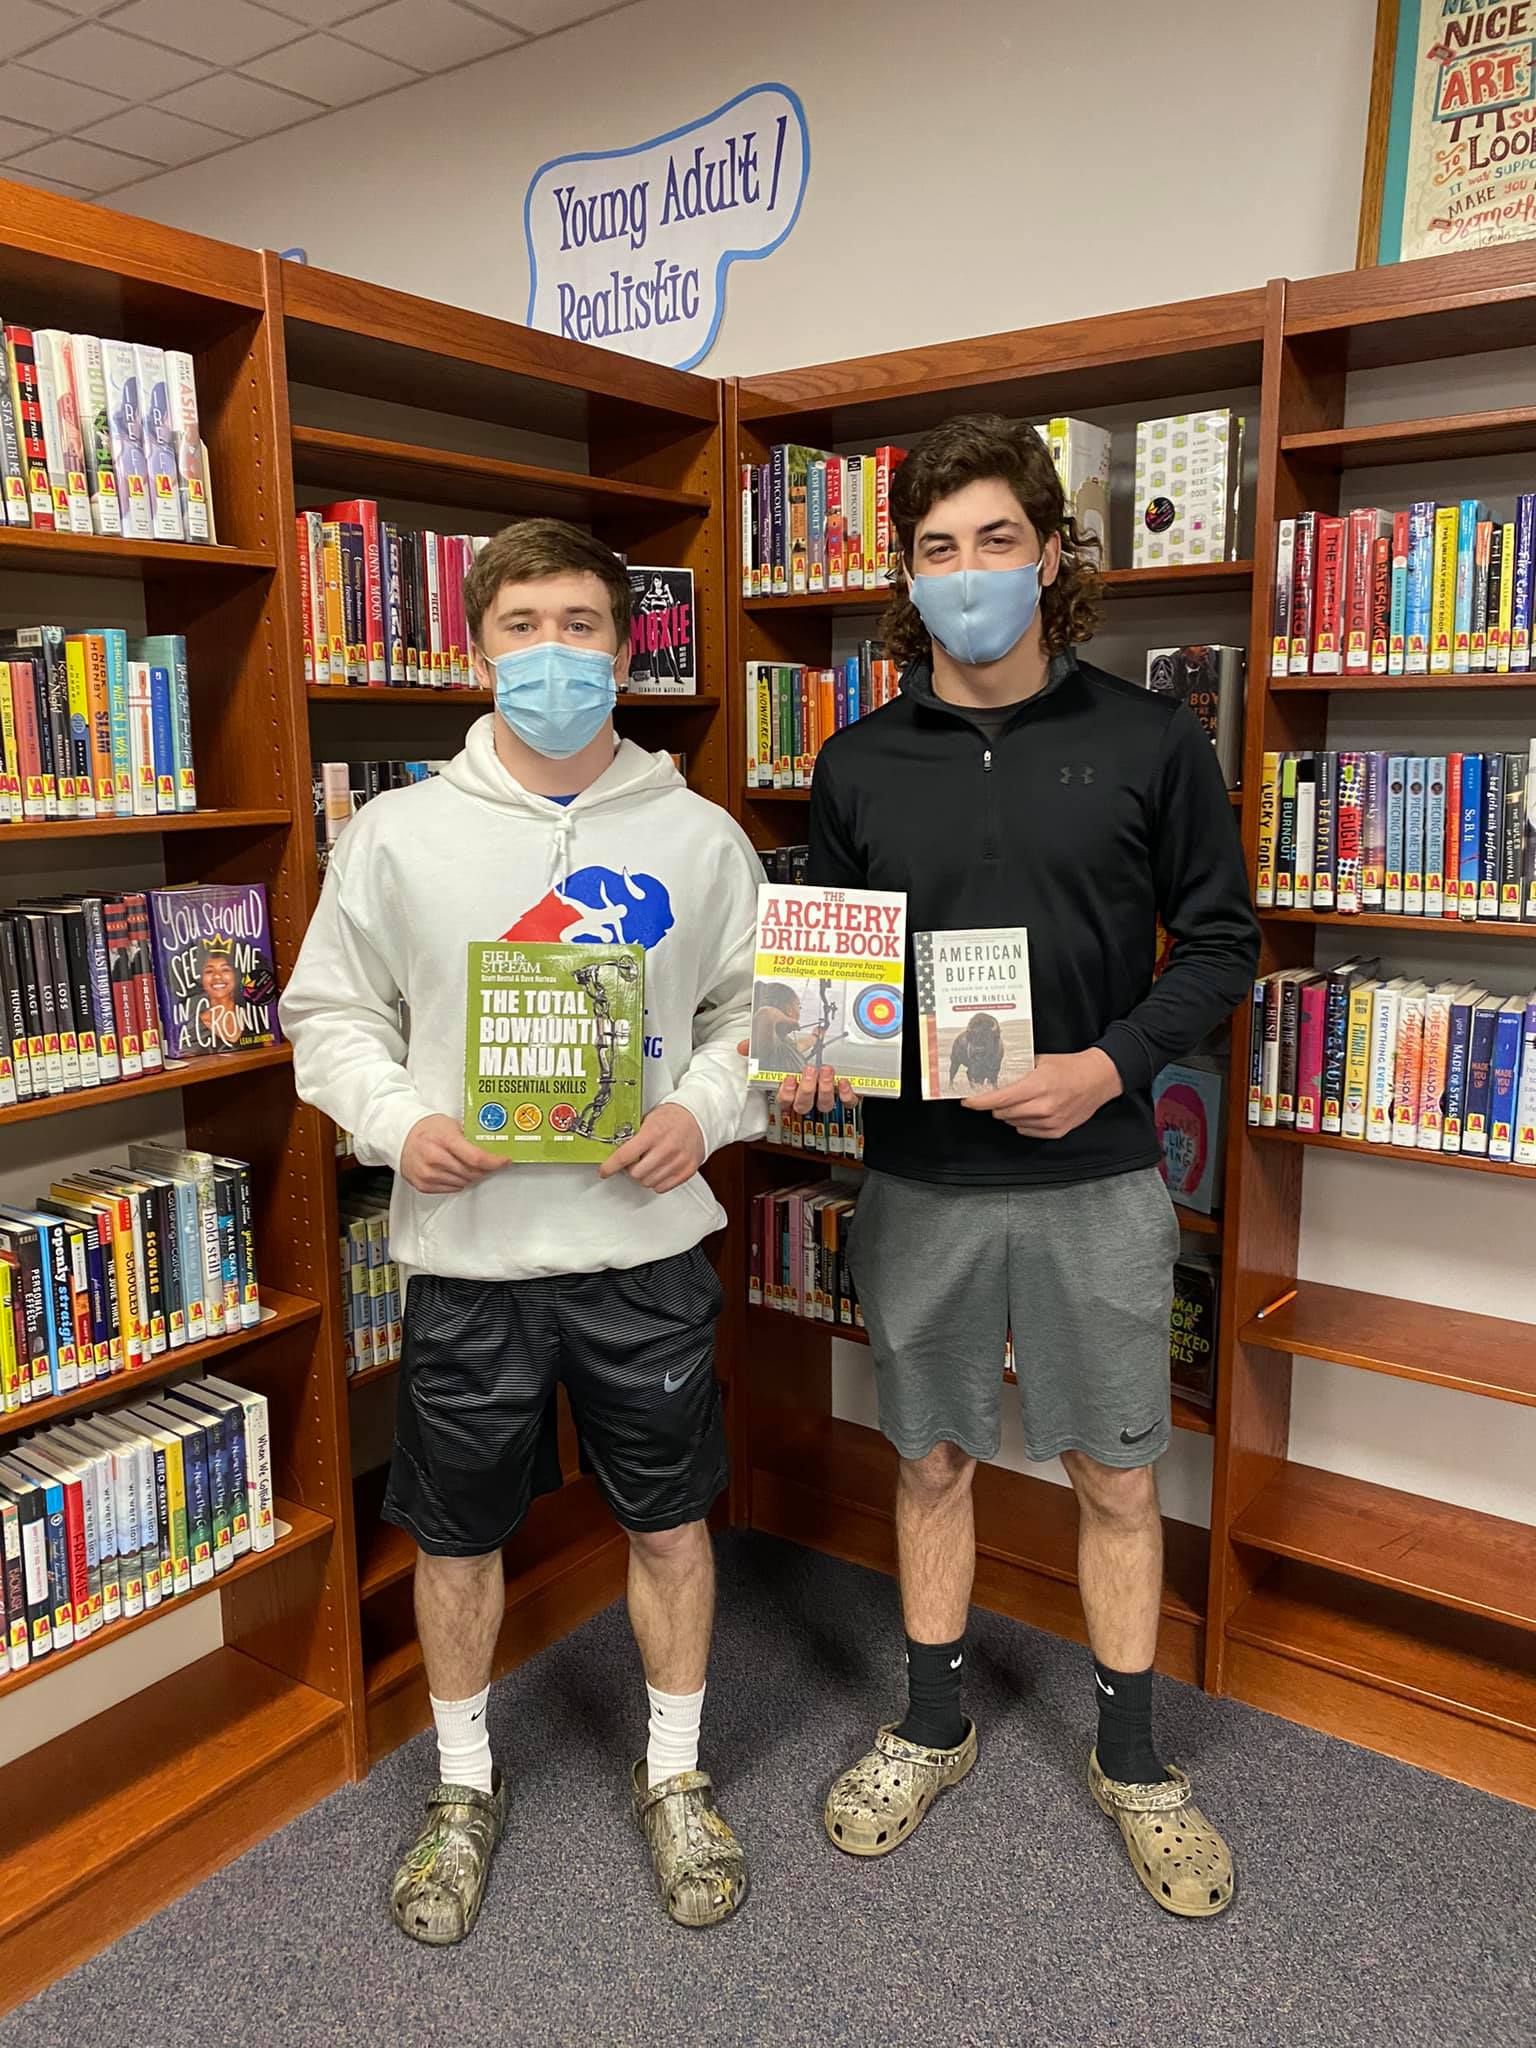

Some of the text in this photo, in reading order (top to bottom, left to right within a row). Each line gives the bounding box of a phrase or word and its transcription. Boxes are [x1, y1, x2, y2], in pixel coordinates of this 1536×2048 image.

[1441, 55, 1521, 110] ART
[553, 181, 650, 251] Young
[659, 131, 760, 226] Adult
[1448, 186, 1495, 219] MAKE
[557, 259, 699, 343] Realistic
[23, 365, 40, 453] WATER ELEPHANTS
[1, 400, 21, 476] STAY WITH ME
[774, 450, 782, 526] JODI PICOULT
[812, 490, 820, 531] PICOULT
[1325, 535, 1338, 561] THE
[368, 544, 382, 621] GINNY MOON
[431, 592, 439, 623] PIECES
[629, 603, 690, 656] MOXIE
[47, 660, 68, 713] Keeper Night
[90, 642, 102, 700] HORNBY
[760, 692, 769, 740] NOWHERE
[1190, 692, 1220, 705] BOY
[95, 711, 111, 753] SLAM
[113, 685, 126, 758] WHEN WAS
[1367, 772, 1380, 820] same sky
[1465, 809, 1475, 821] So
[1280, 802, 1293, 861] BURNOUT
[1316, 799, 1332, 869] DEADFALL
[1340, 813, 1357, 853] FUGLY
[1390, 797, 1400, 846] PIECING ME
[1409, 797, 1421, 847] PIECING ME
[1430, 797, 1441, 847] PIECING ME
[1464, 823, 1475, 833] B.
[1485, 832, 1496, 860] perfect
[1506, 840, 1514, 880] SURVIVAL
[762, 899, 902, 934] ARCHERY
[824, 891, 845, 902] THE
[158, 889, 263, 950] YOU SHOULD
[94, 948, 107, 971] LAST
[760, 928, 900, 958] DRILL BOOK
[773, 955, 794, 965] 130
[796, 958, 818, 966] drills
[829, 960, 863, 969] improve
[939, 944, 1022, 962] AMERICAN
[171, 946, 201, 997] SEE
[481, 962, 541, 974] STREAM
[836, 969, 885, 980] consistency
[946, 965, 1016, 982] BUFFALO
[10, 989, 23, 1036] HUNGER
[27, 984, 39, 1016] RAGE
[43, 985, 55, 1012] LOSS
[58, 982, 69, 1010] LOSS
[79, 984, 89, 1015] BREATH
[480, 989, 588, 1015] THE TOTAL
[949, 994, 1016, 1004] STEVEN RINELLA
[1330, 984, 1345, 1035] BLINK
[173, 997, 270, 1048] IN CROWN
[179, 1024, 191, 1050] A
[1265, 1009, 1277, 1039] HUSH
[1378, 1006, 1389, 1063] EVERYTHING
[1429, 1032, 1439, 1053] SUN
[478, 1046, 586, 1077] MANUAL
[1429, 1056, 1437, 1066] IS
[1452, 1044, 1463, 1072] MADE
[478, 1079, 586, 1094] 261 ESSENTIAL SKILLS
[858, 1078, 896, 1088] GERARD
[1402, 1068, 1412, 1094] ALSO
[1426, 1067, 1437, 1093] ALSO
[1448, 1087, 1460, 1118] STARS
[167, 1190, 181, 1283] Catfishing CatNet
[204, 1211, 221, 1275] hold still
[226, 1218, 236, 1233] WE
[227, 1235, 236, 1251] ARE
[146, 1231, 160, 1295] SCOWLER
[31, 1268, 43, 1317] PERSONAL
[52, 1227, 75, 1346] openly straigh
[107, 1260, 120, 1328] THE JUVIE THREE
[125, 1252, 139, 1316] SCHOOLED
[25, 1293, 37, 1333] EFFECTS
[1172, 1297, 1203, 1316] MAP
[156, 1456, 167, 1525] HERO WORSHIP
[257, 1434, 269, 1511] When We Collide
[104, 1487, 113, 1528] we were
[128, 1483, 137, 1523] we were
[144, 1477, 154, 1516] we were
[72, 1533, 88, 1597] FRANKIE
